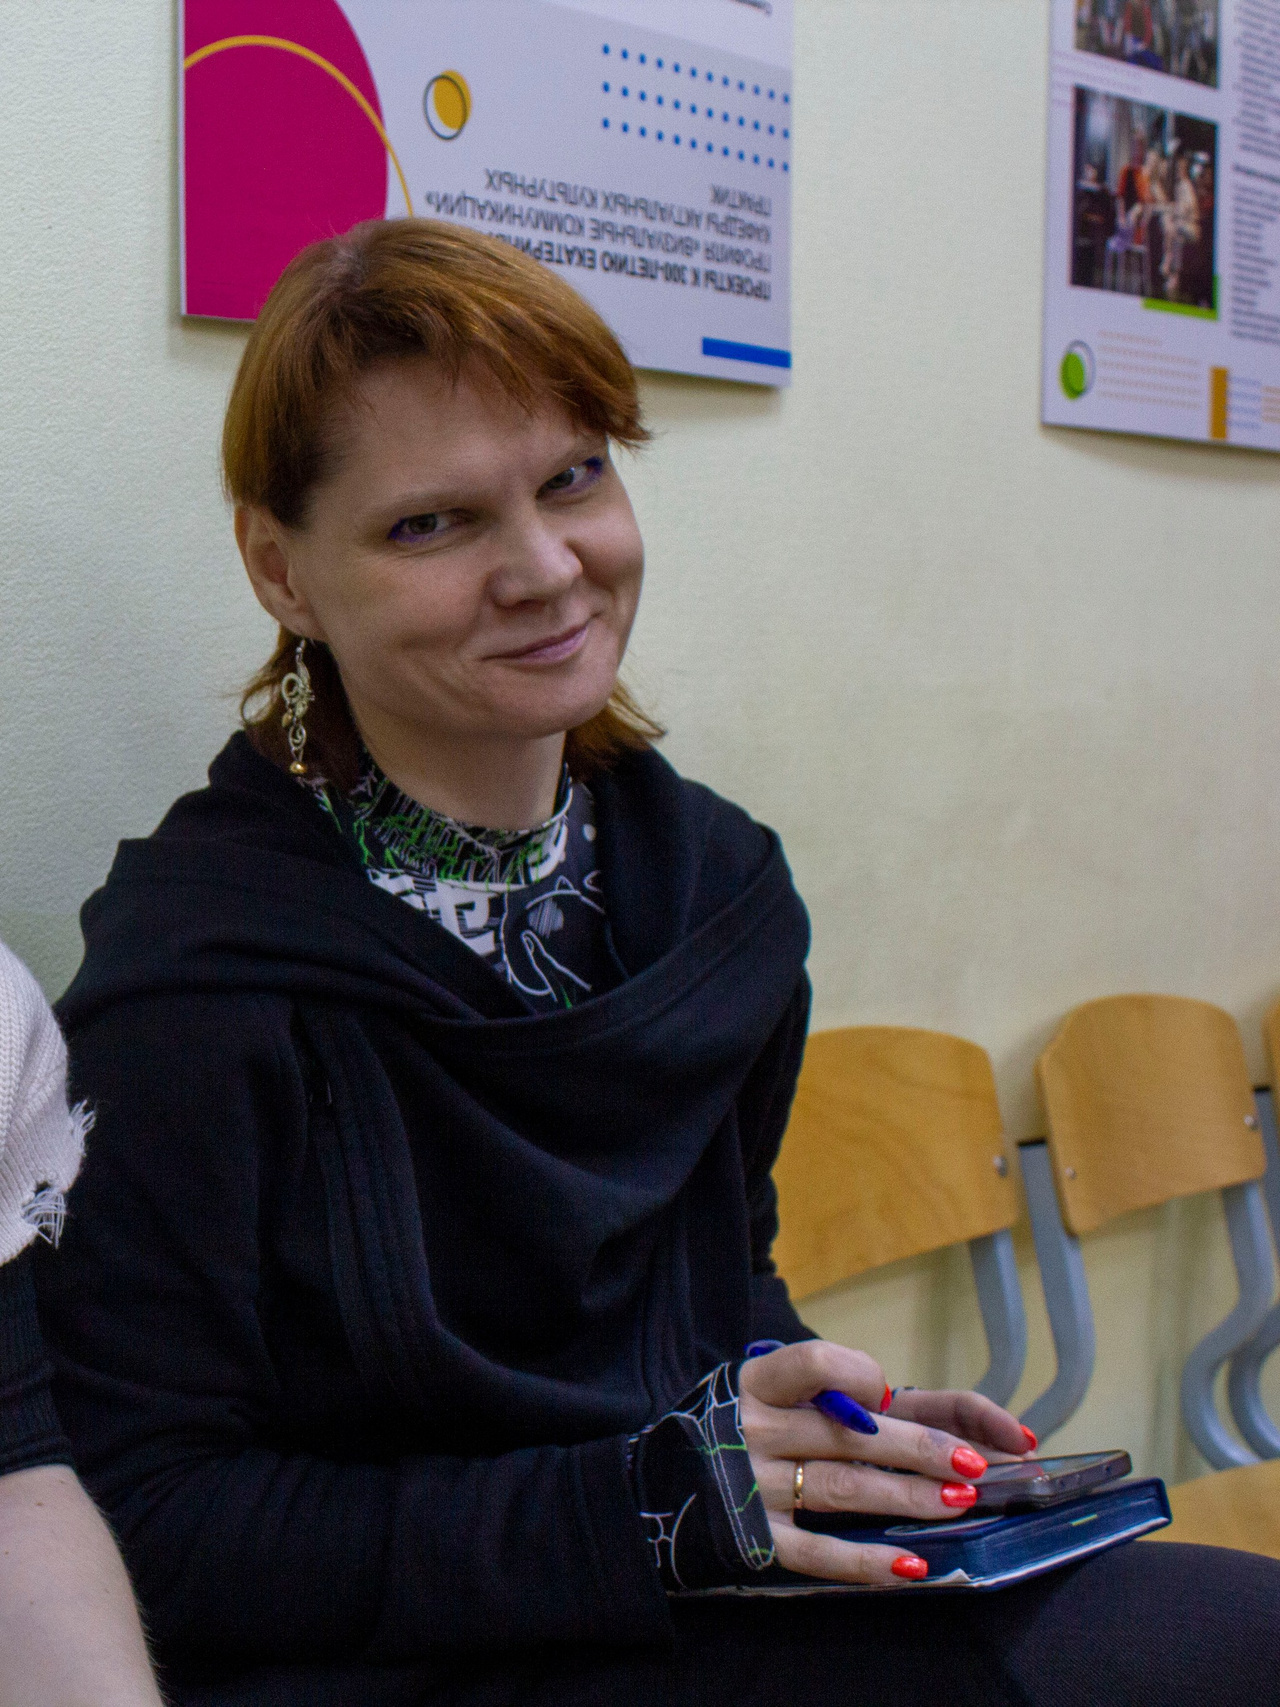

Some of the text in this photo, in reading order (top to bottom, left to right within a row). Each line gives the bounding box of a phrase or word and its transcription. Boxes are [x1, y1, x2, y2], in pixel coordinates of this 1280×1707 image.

[425, 191, 585, 237] КОММУНИКАЦИИ»
[485, 169, 771, 245] КАФЕДРЫ АКТУАЛЬНЫХ КУЛЬТУРНЫХ
[710, 185, 771, 217] ПРАКТИК
[601, 251, 687, 286] 300-ЛЕТИЮ
[704, 242, 771, 275] ПРОФИЛЯ
[691, 269, 701, 289] К
[704, 270, 771, 301] ПРОЕКТЫ
